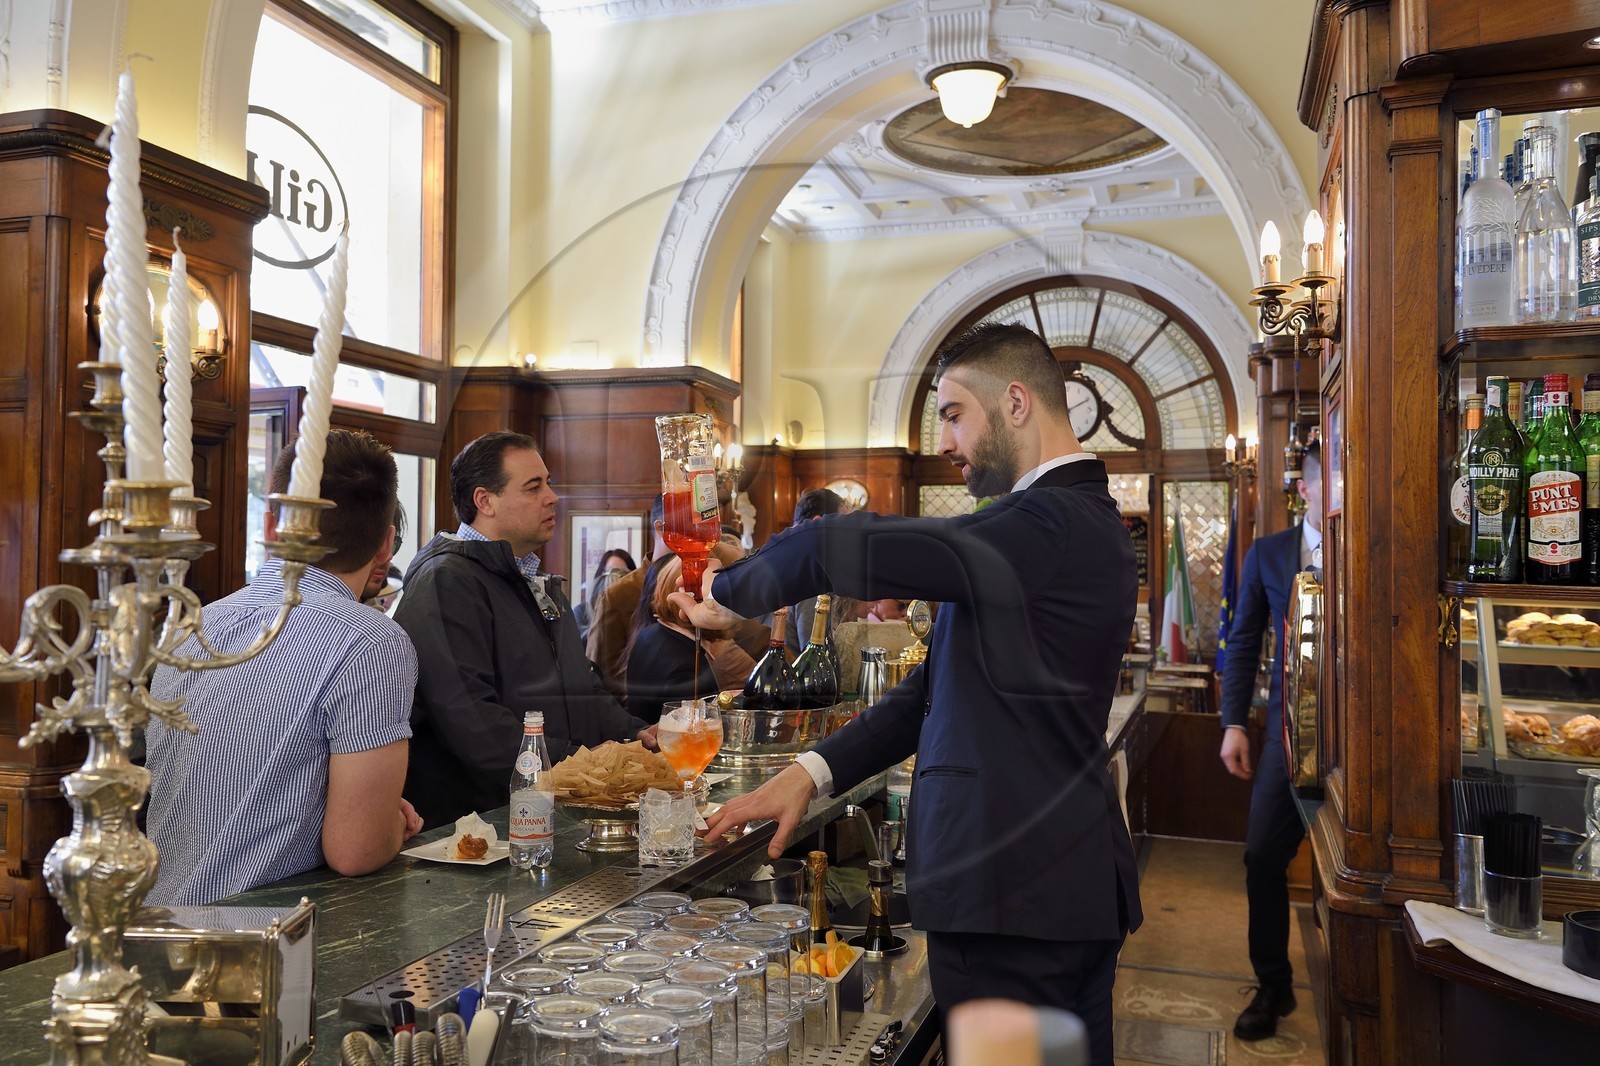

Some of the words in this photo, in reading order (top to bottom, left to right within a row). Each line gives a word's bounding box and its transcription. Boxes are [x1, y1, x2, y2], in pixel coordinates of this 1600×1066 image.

[1496, 467, 1519, 478] PRAT
[1530, 484, 1572, 502] PUNT
[1532, 503, 1539, 511] E
[1539, 496, 1580, 513] MES
[525, 817, 546, 826] PANNA
